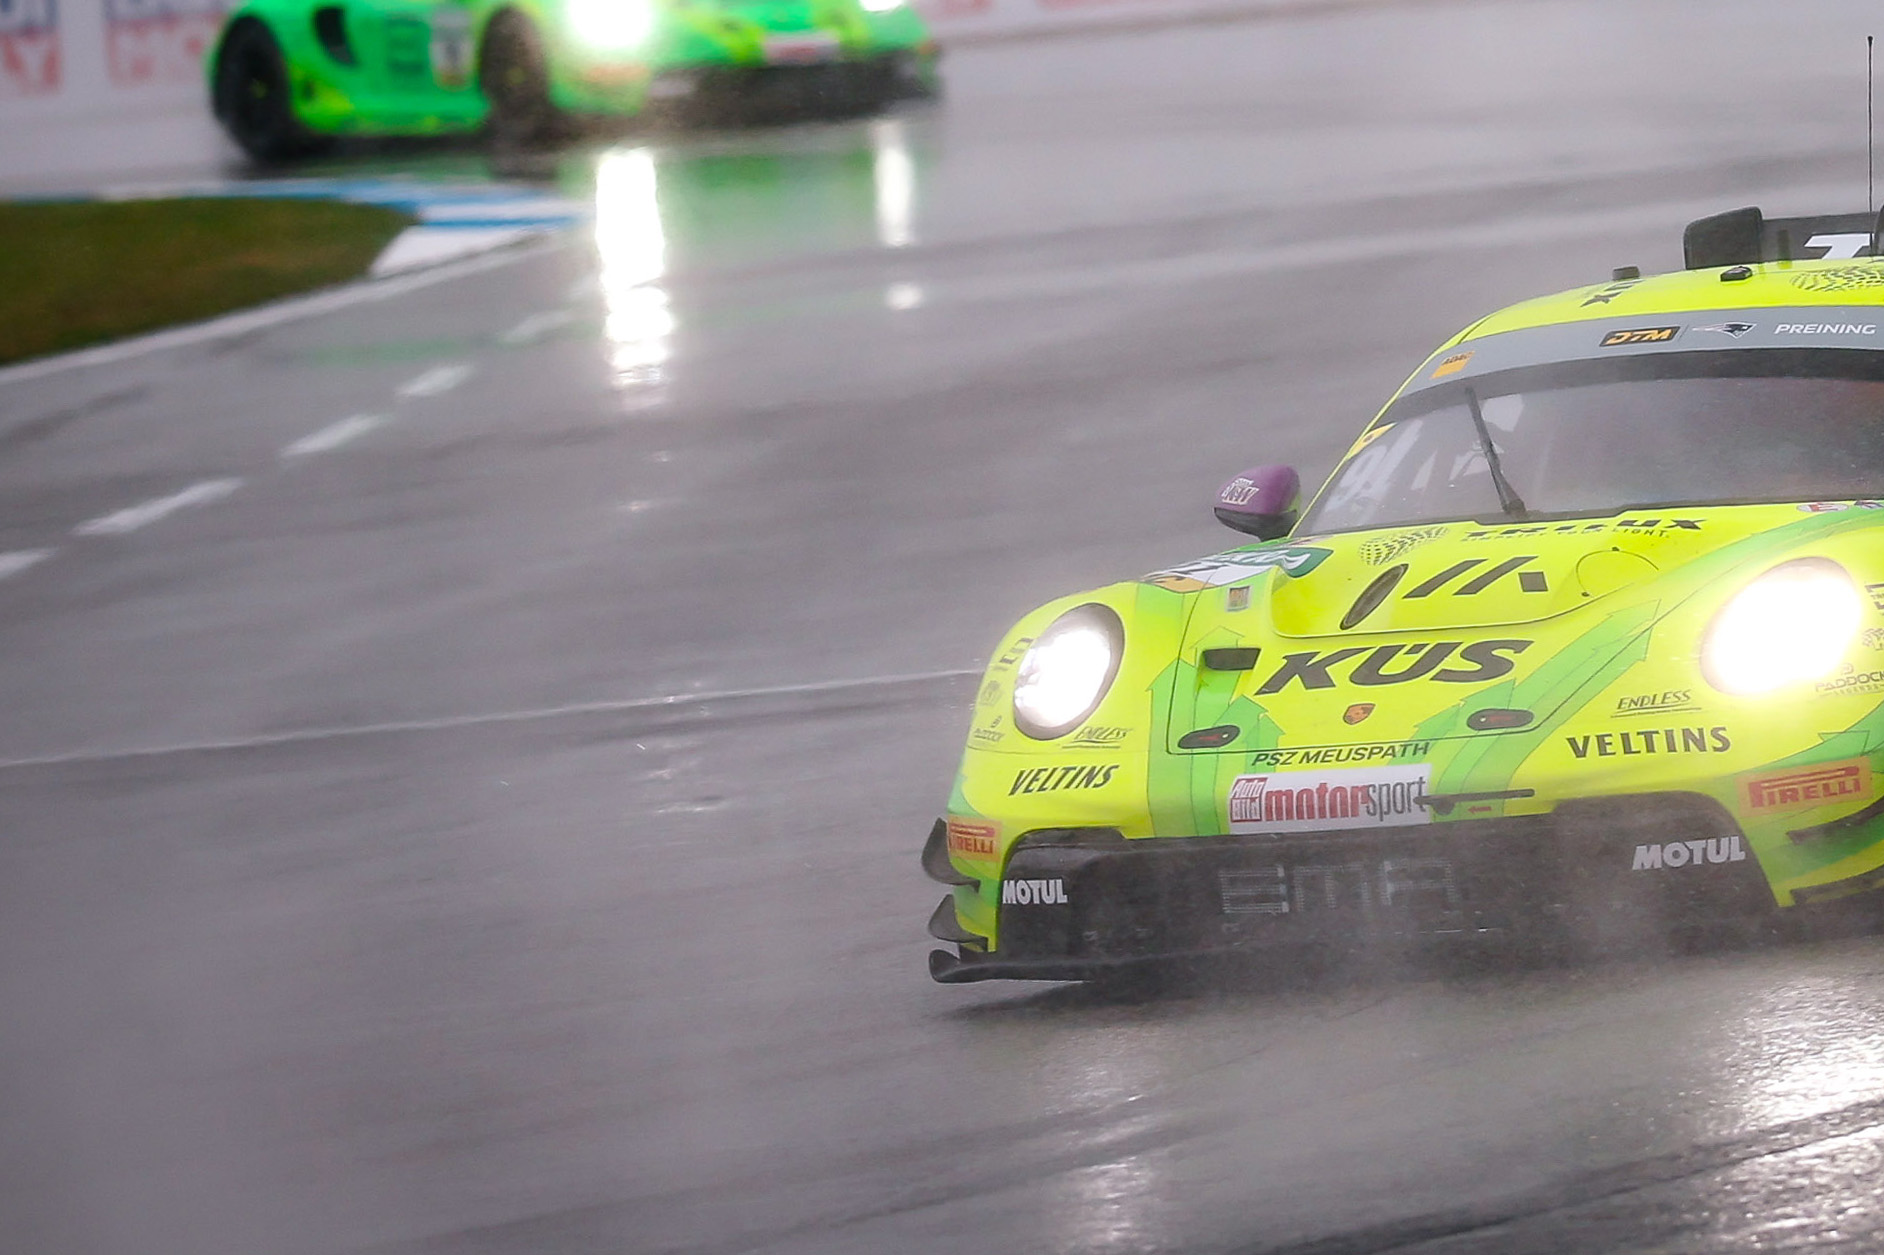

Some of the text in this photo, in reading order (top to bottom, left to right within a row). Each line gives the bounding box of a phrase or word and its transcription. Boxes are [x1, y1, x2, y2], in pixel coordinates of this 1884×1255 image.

[1603, 329, 1674, 344] DTM
[1774, 323, 1876, 335] PREINING
[1256, 640, 1533, 695] KÜS
[1617, 690, 1692, 710] ENDLESS
[1252, 742, 1430, 766] PSZ MEUSPATH
[1566, 726, 1731, 759] VELTINS
[1009, 764, 1121, 796] VELTINS
[1749, 766, 1862, 808] PIRELLI
[1265, 776, 1427, 821] motorsport
[1632, 836, 1746, 871] MOTUL
[1003, 879, 1068, 905] MOTUL
